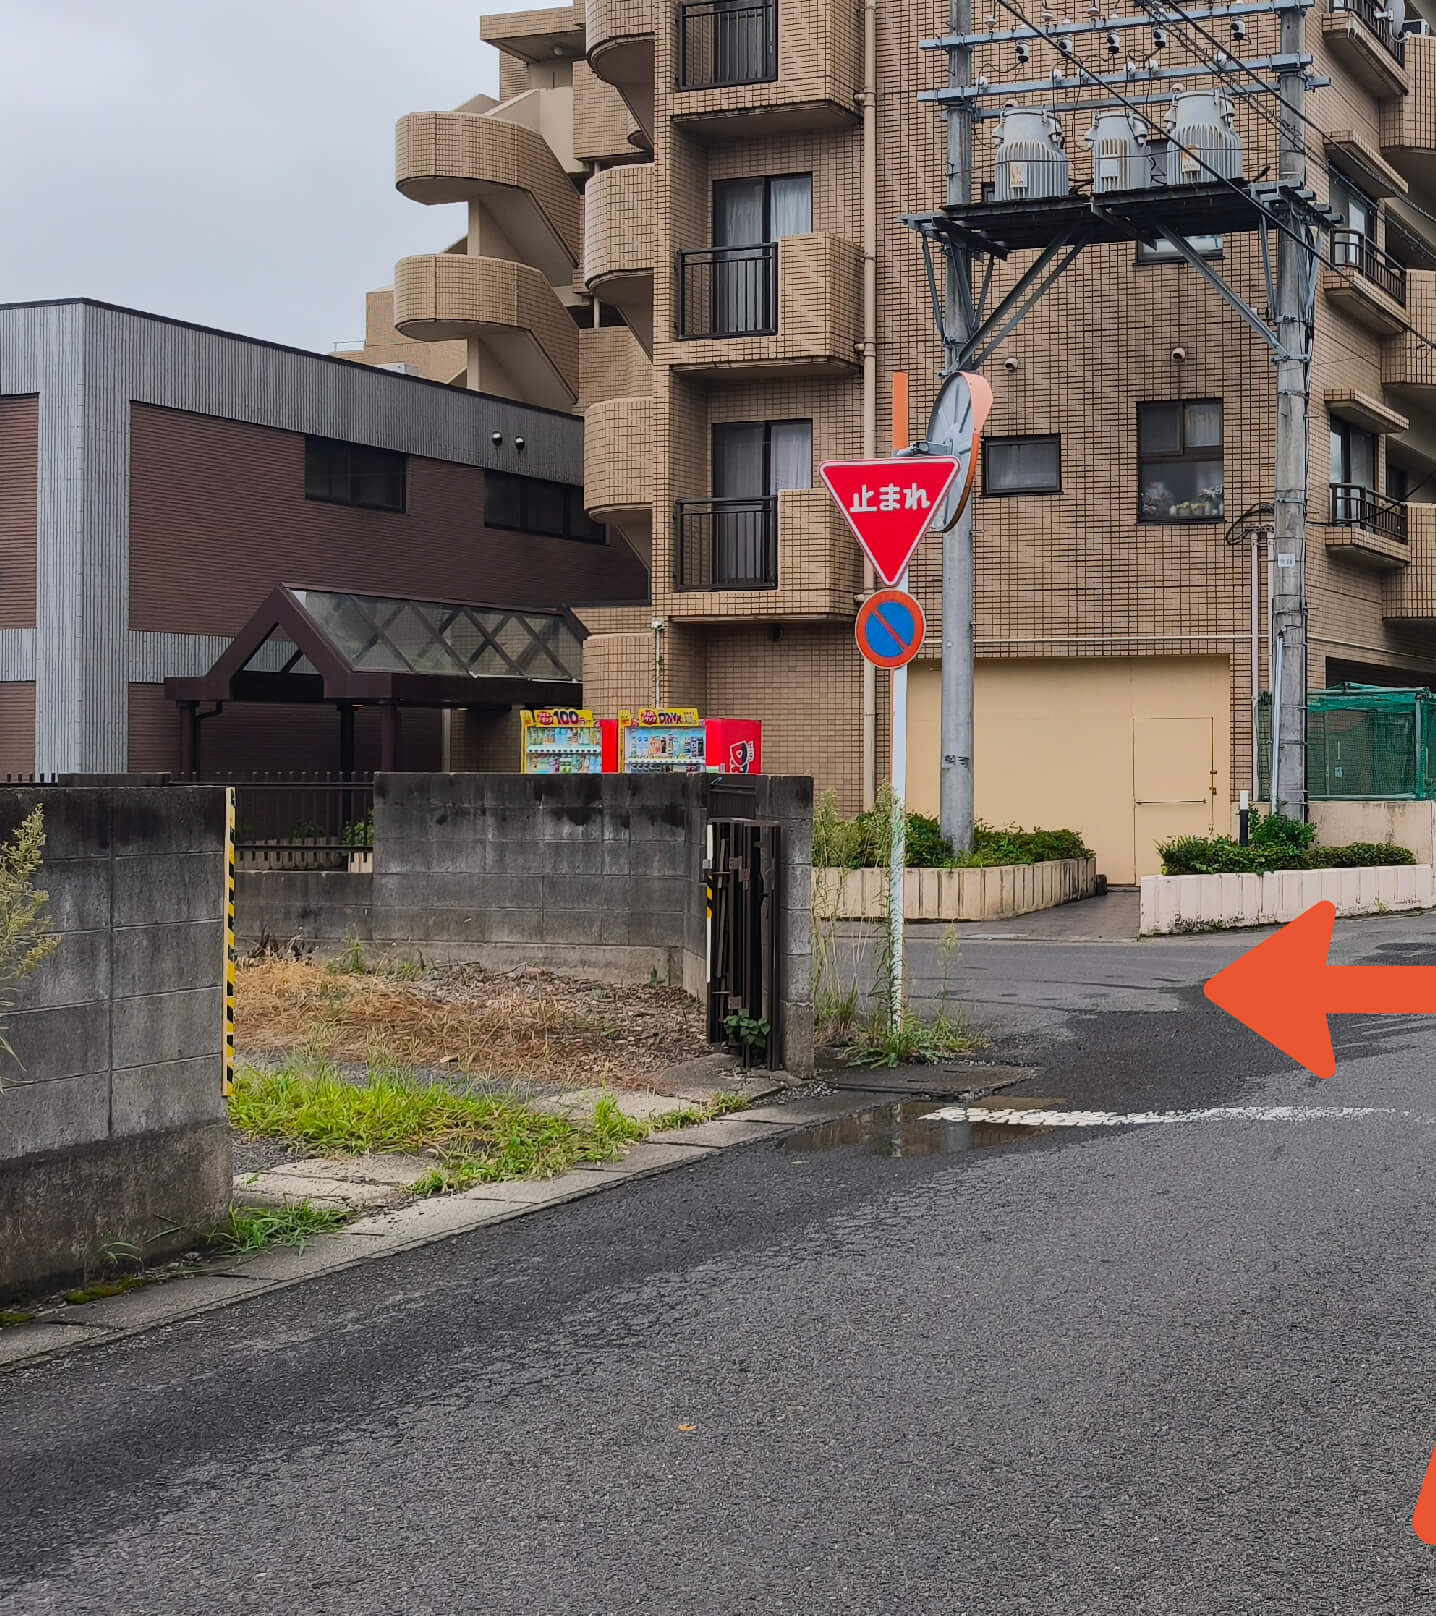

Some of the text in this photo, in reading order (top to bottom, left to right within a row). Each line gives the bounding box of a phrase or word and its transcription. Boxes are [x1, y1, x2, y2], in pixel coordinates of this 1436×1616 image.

[850, 482, 931, 513] 止まれ
[552, 709, 580, 726] 100
